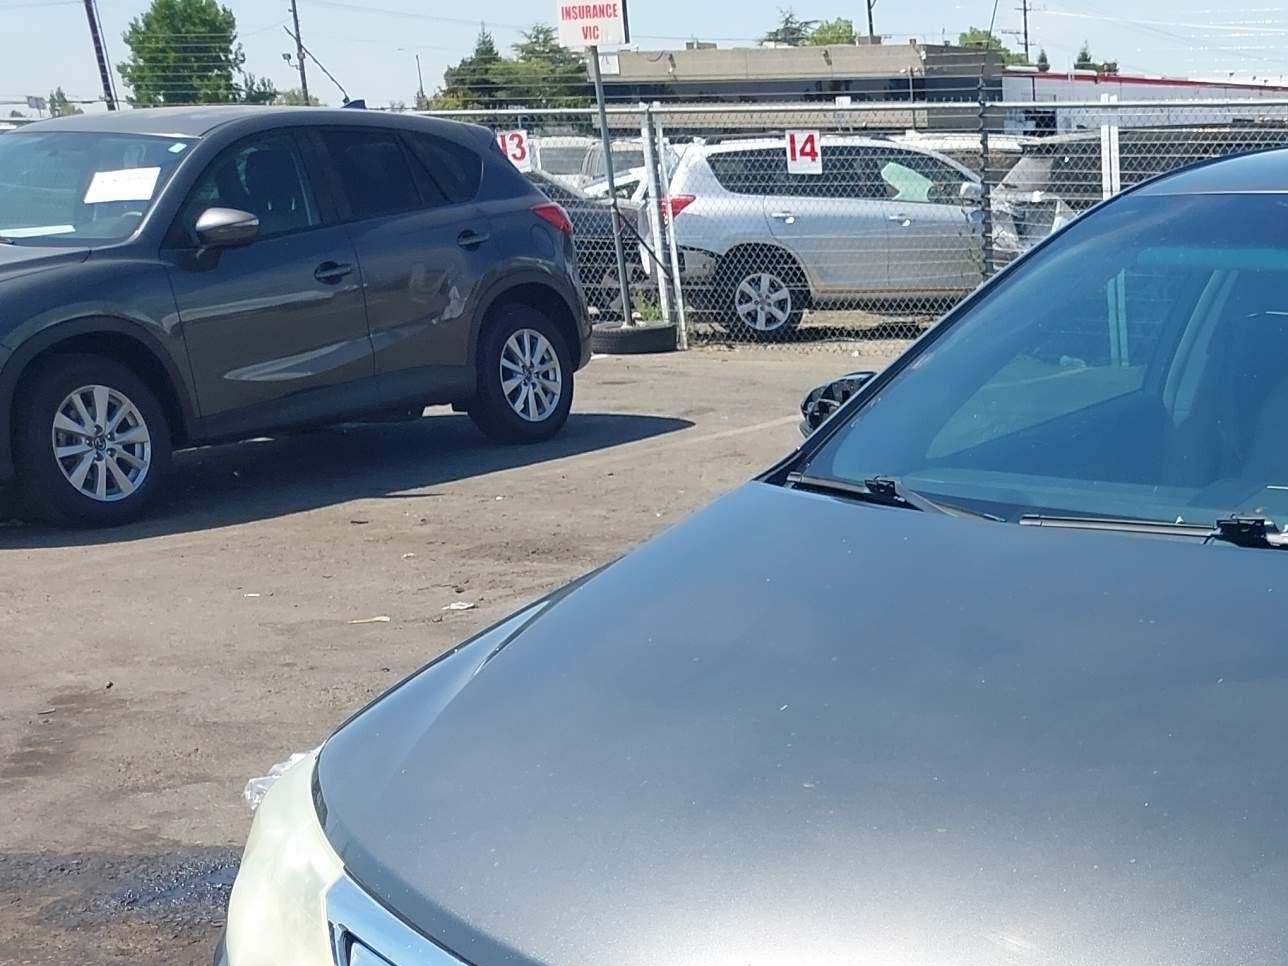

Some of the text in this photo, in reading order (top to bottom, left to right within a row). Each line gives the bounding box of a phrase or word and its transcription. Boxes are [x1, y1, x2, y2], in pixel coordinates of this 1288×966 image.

[561, 3, 618, 21] INSURANCE
[581, 25, 600, 40] VIC
[500, 133, 526, 161] 13
[789, 134, 818, 161] 14
